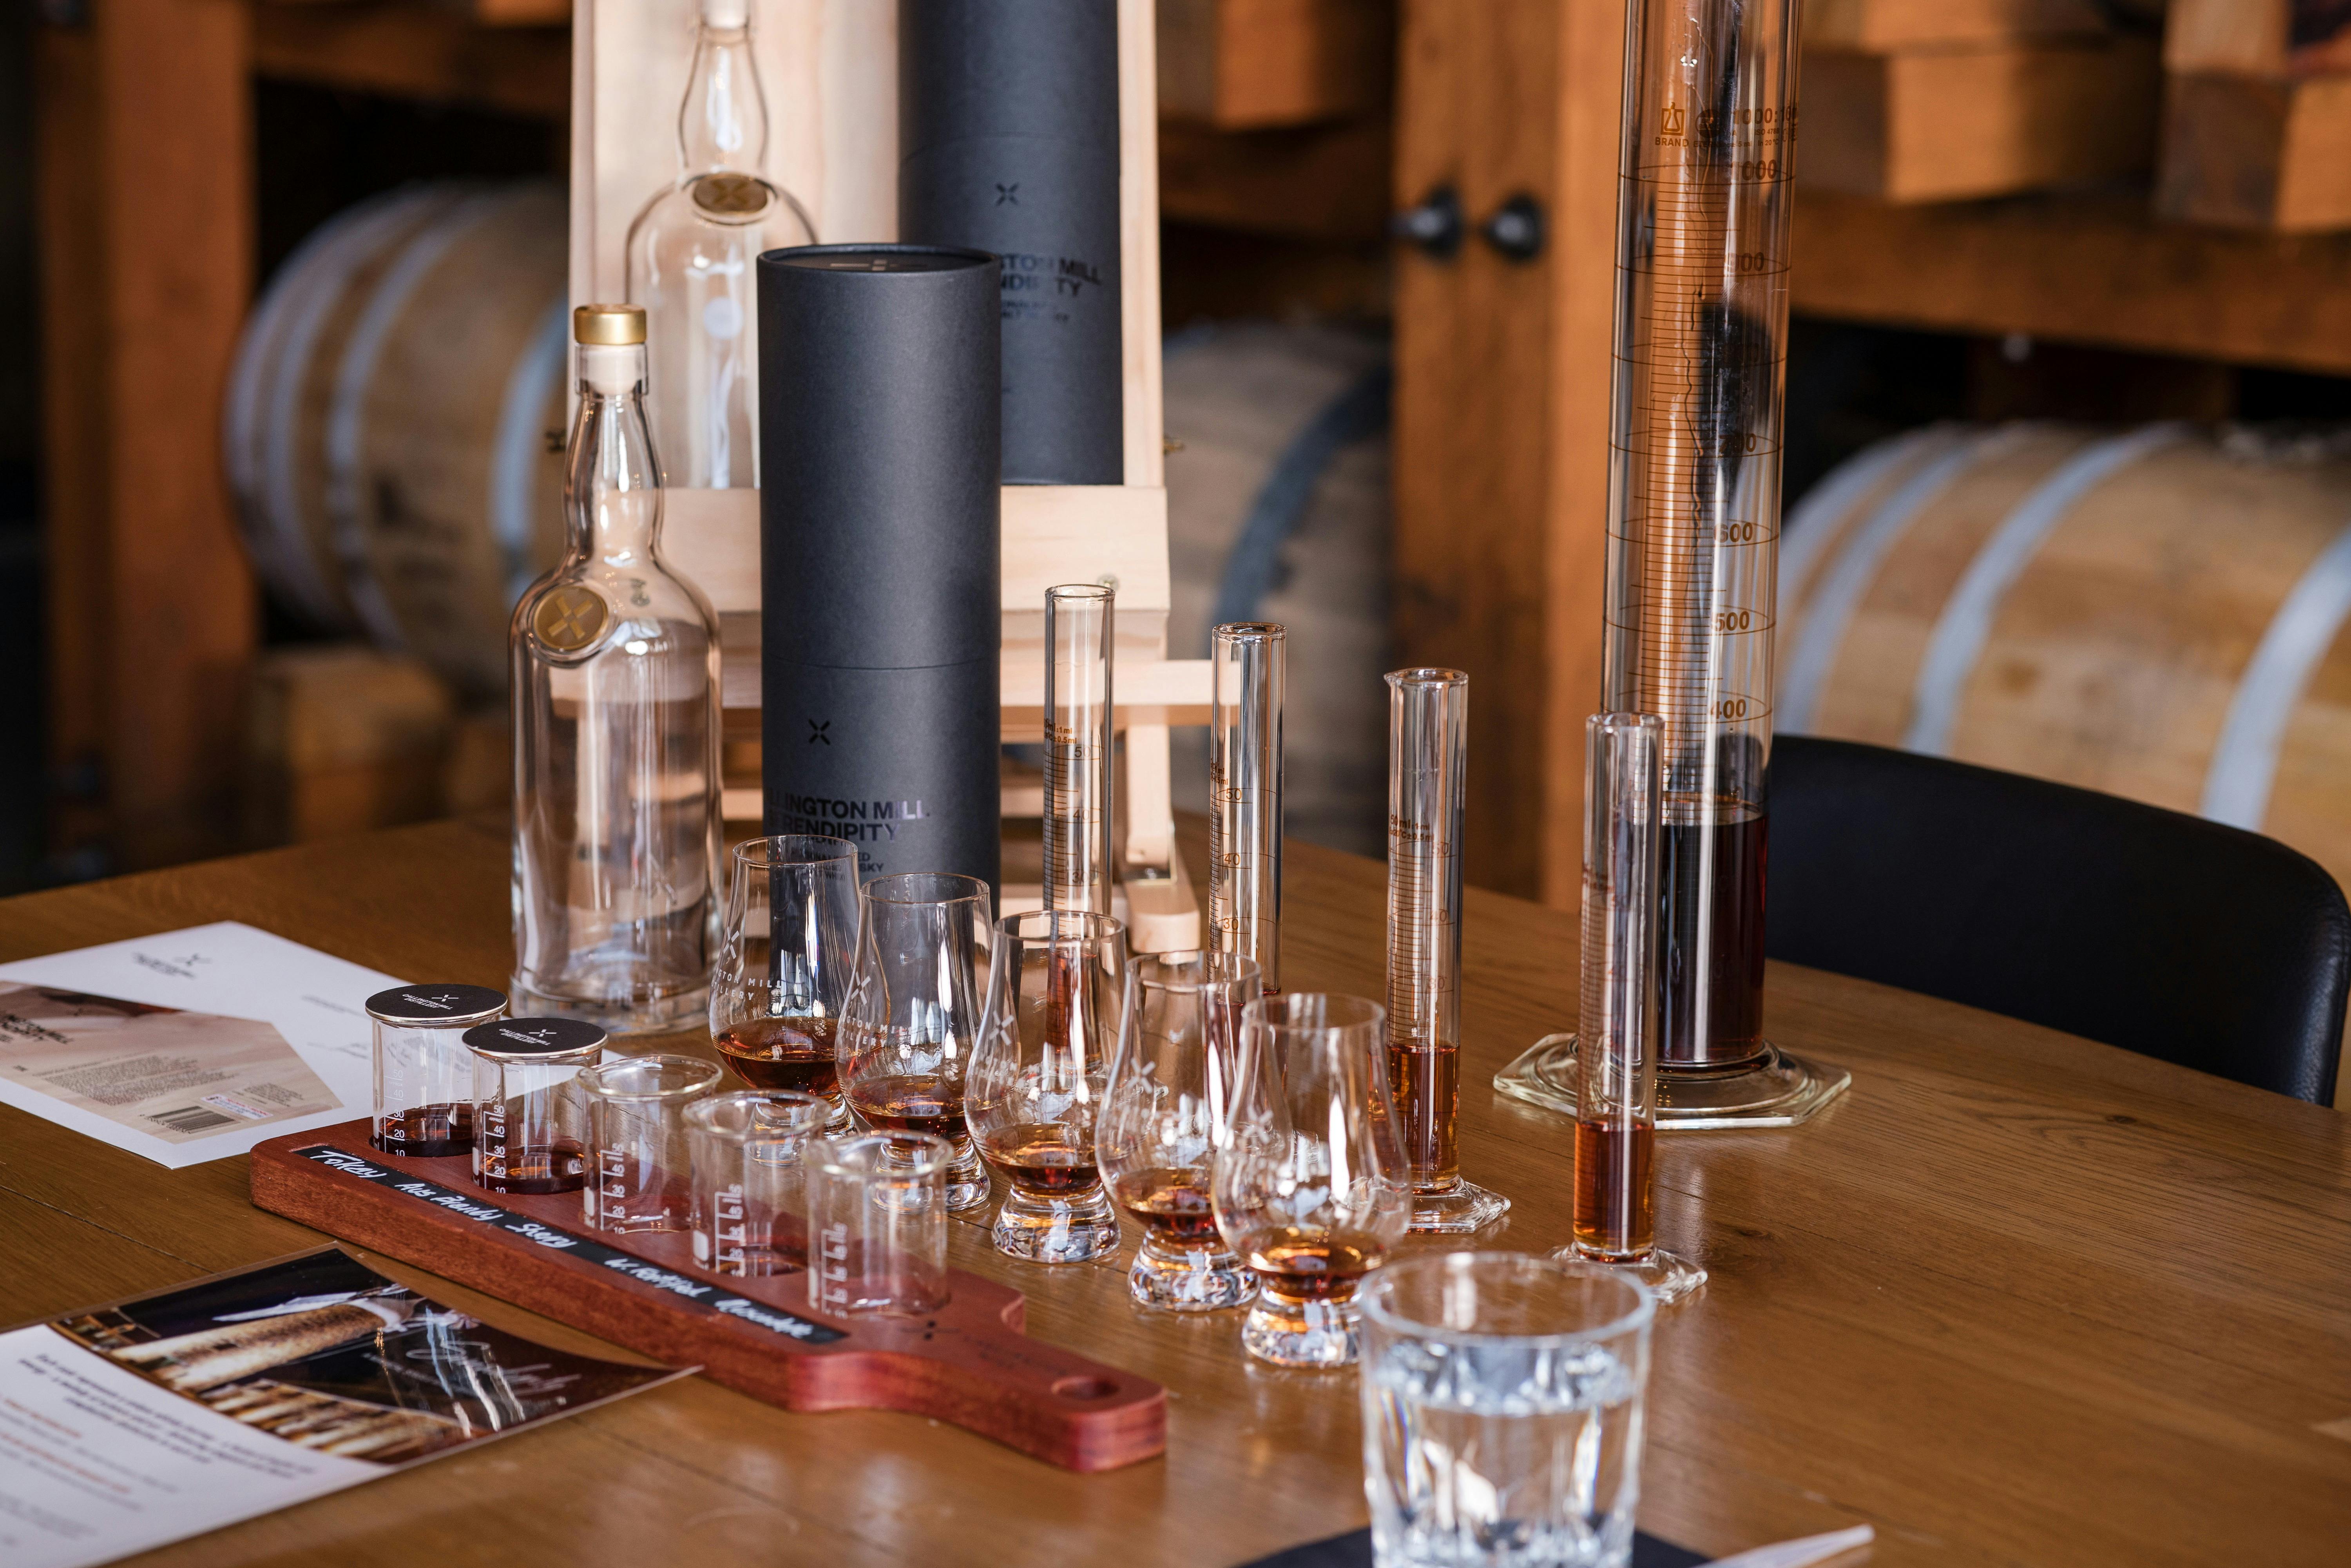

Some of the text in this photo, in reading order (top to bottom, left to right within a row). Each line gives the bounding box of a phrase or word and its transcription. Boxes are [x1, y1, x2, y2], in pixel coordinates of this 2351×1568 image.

[1655, 137, 1689, 147] BRAND
[1719, 433, 1756, 453] 700
[1715, 522, 1753, 543] 600
[1711, 610, 1750, 632] 500
[1711, 699, 1746, 720] 400
[1074, 746, 1090, 757] 50
[1226, 788, 1242, 800] 50
[1073, 809, 1089, 820] 40
[1224, 854, 1241, 865] 40
[1223, 918, 1239, 930] 30
[748, 978, 782, 988] MILL
[402, 994, 440, 1006] CALLINGTON
[404, 998, 440, 1008] DISTILLERY
[499, 1028, 538, 1041] CALLINGTON
[500, 1033, 537, 1044] DISTILLERY
[393, 1069, 403, 1078] 50
[393, 1089, 403, 1098] 40
[394, 1109, 404, 1118] 30
[494, 1105, 505, 1114] 50
[394, 1129, 405, 1138] 20
[494, 1125, 505, 1135] 40
[494, 1145, 505, 1155] 30
[612, 1143, 624, 1153] 50
[310, 1150, 387, 1179] Tokay
[612, 1164, 625, 1174] 40
[494, 1166, 505, 1176] 20
[612, 1184, 625, 1195] 30
[612, 1205, 625, 1215] 20
[614, 1226, 626, 1235] 10
[729, 1247, 744, 1258] 20
